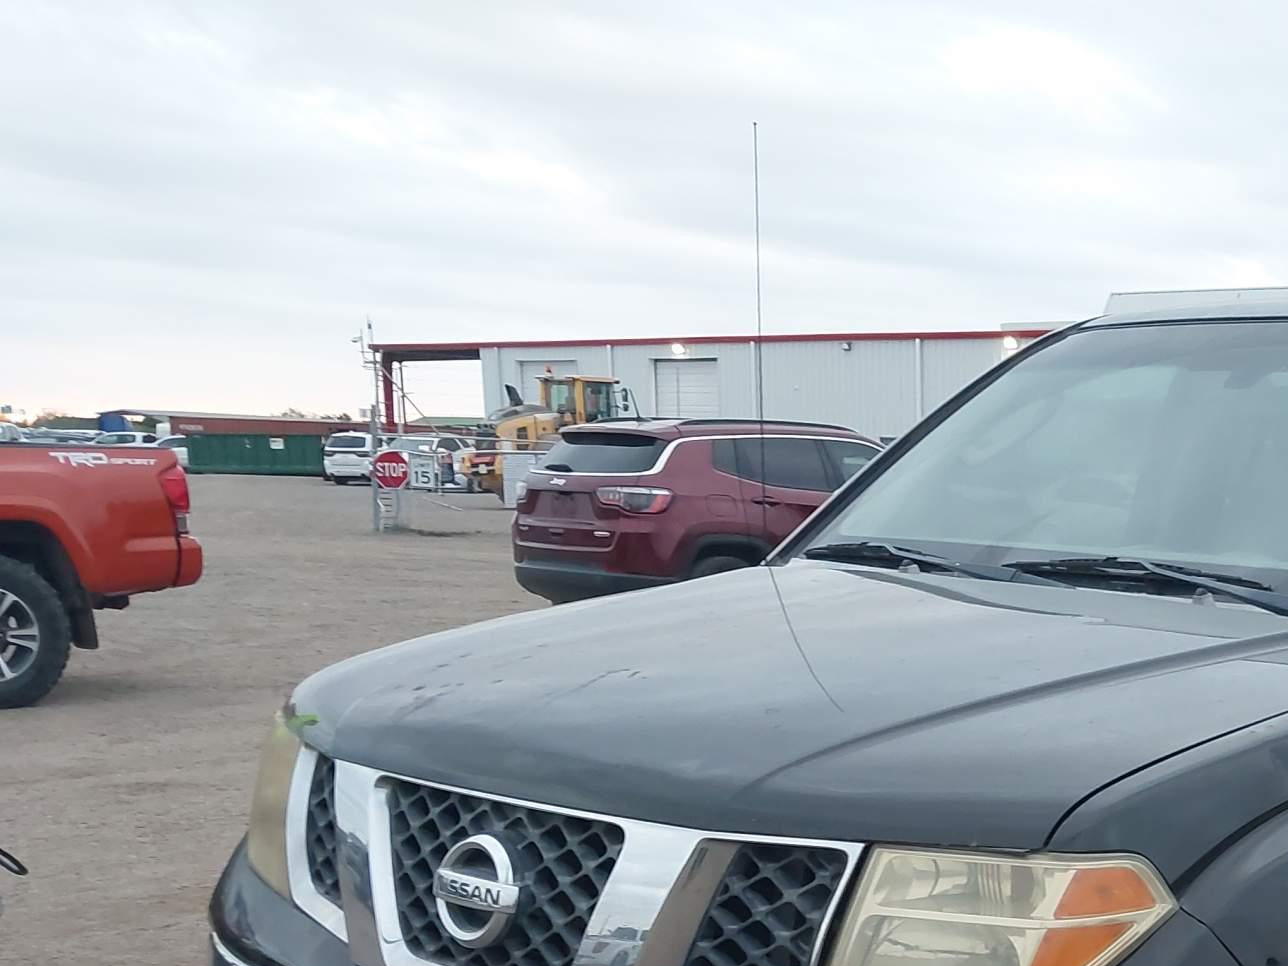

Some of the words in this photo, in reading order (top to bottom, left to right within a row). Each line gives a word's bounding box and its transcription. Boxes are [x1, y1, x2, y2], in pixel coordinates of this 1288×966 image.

[48, 451, 109, 468] TRD
[375, 462, 407, 477] STOP
[414, 470, 431, 484] 15
[440, 876, 502, 908] SSAN
